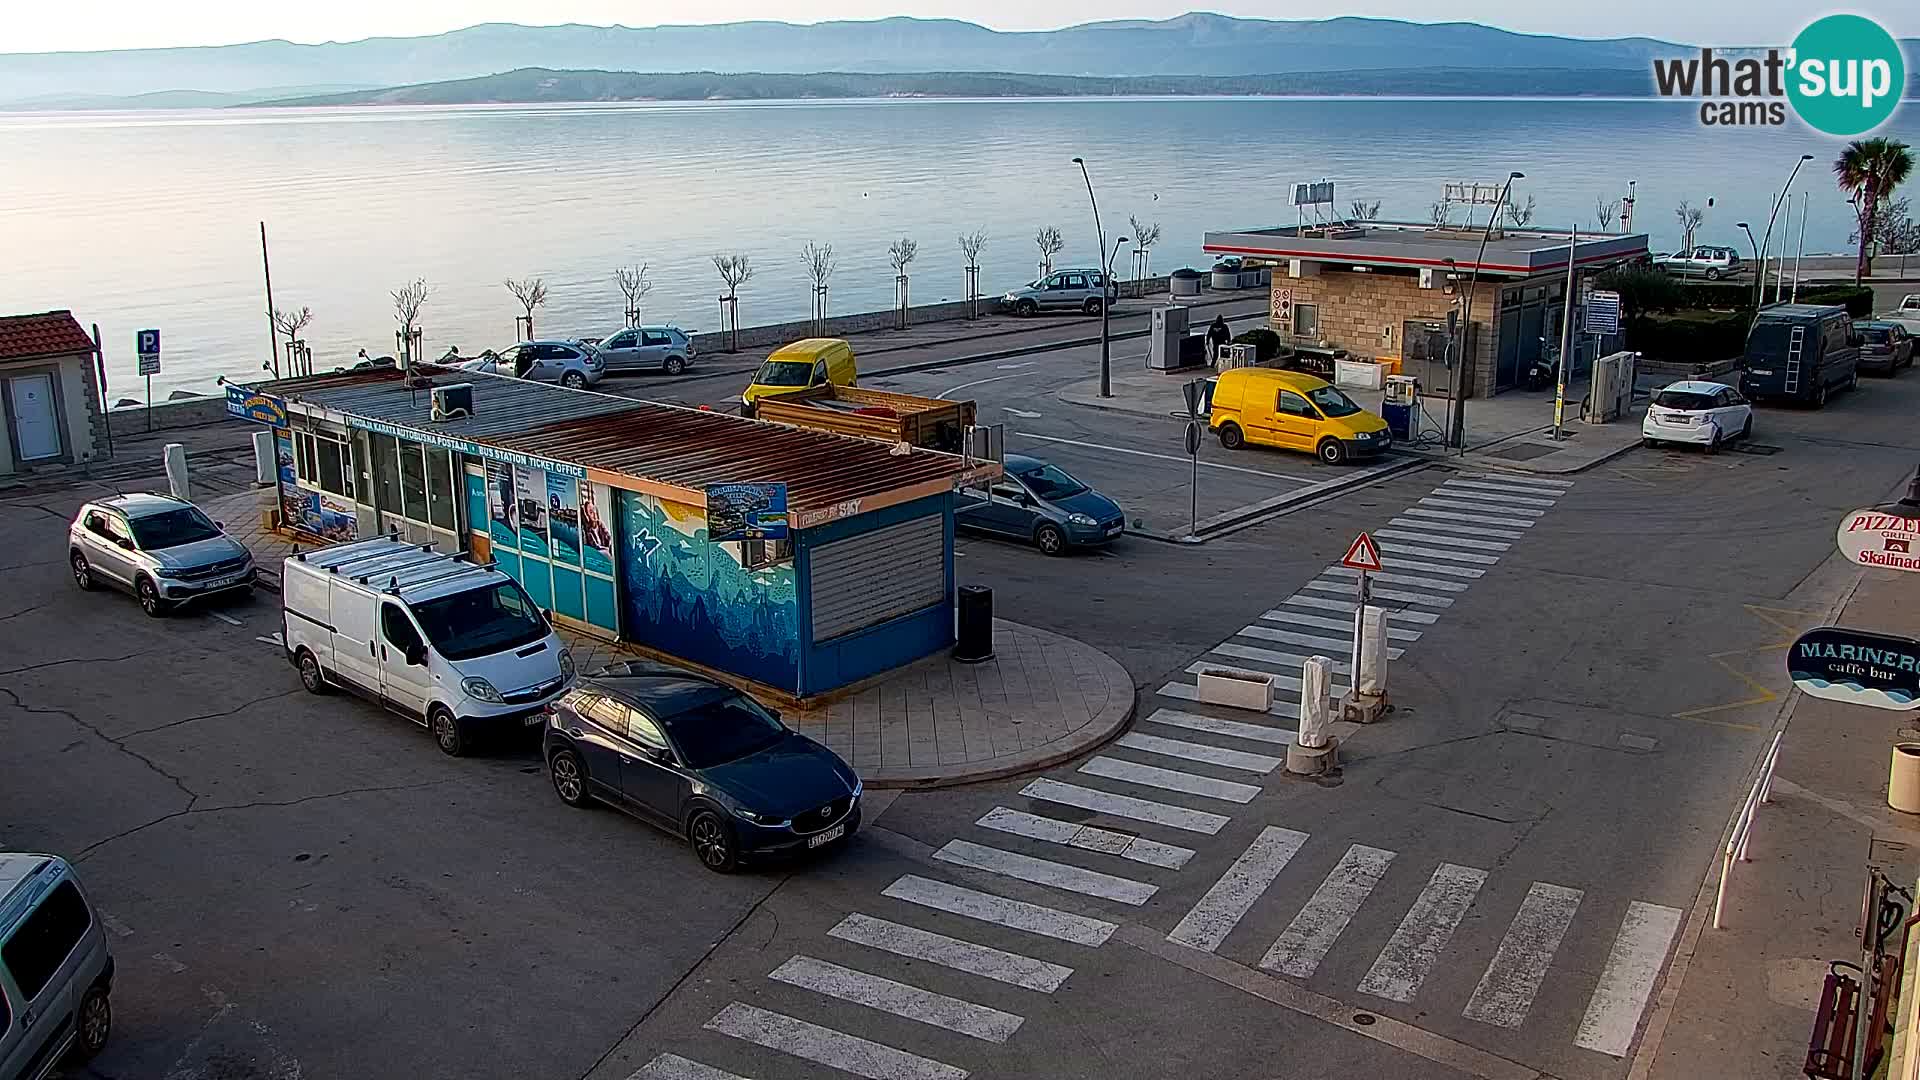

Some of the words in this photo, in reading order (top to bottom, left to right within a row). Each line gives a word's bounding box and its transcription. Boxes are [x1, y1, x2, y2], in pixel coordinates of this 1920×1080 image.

[143, 333, 155, 351] P
[397, 427, 437, 445] AUTOBUSNA
[437, 436, 468, 451] POSTAJA
[479, 446, 494, 457] BUS
[495, 449, 527, 465] STATION
[528, 456, 555, 472] TICKET
[556, 463, 583, 477] OFFICE
[1848, 516, 1920, 535] PIZZE
[1881, 531, 1917, 541] GRILL
[1828, 663, 1865, 676] caffe
[1870, 666, 1896, 681] bar
